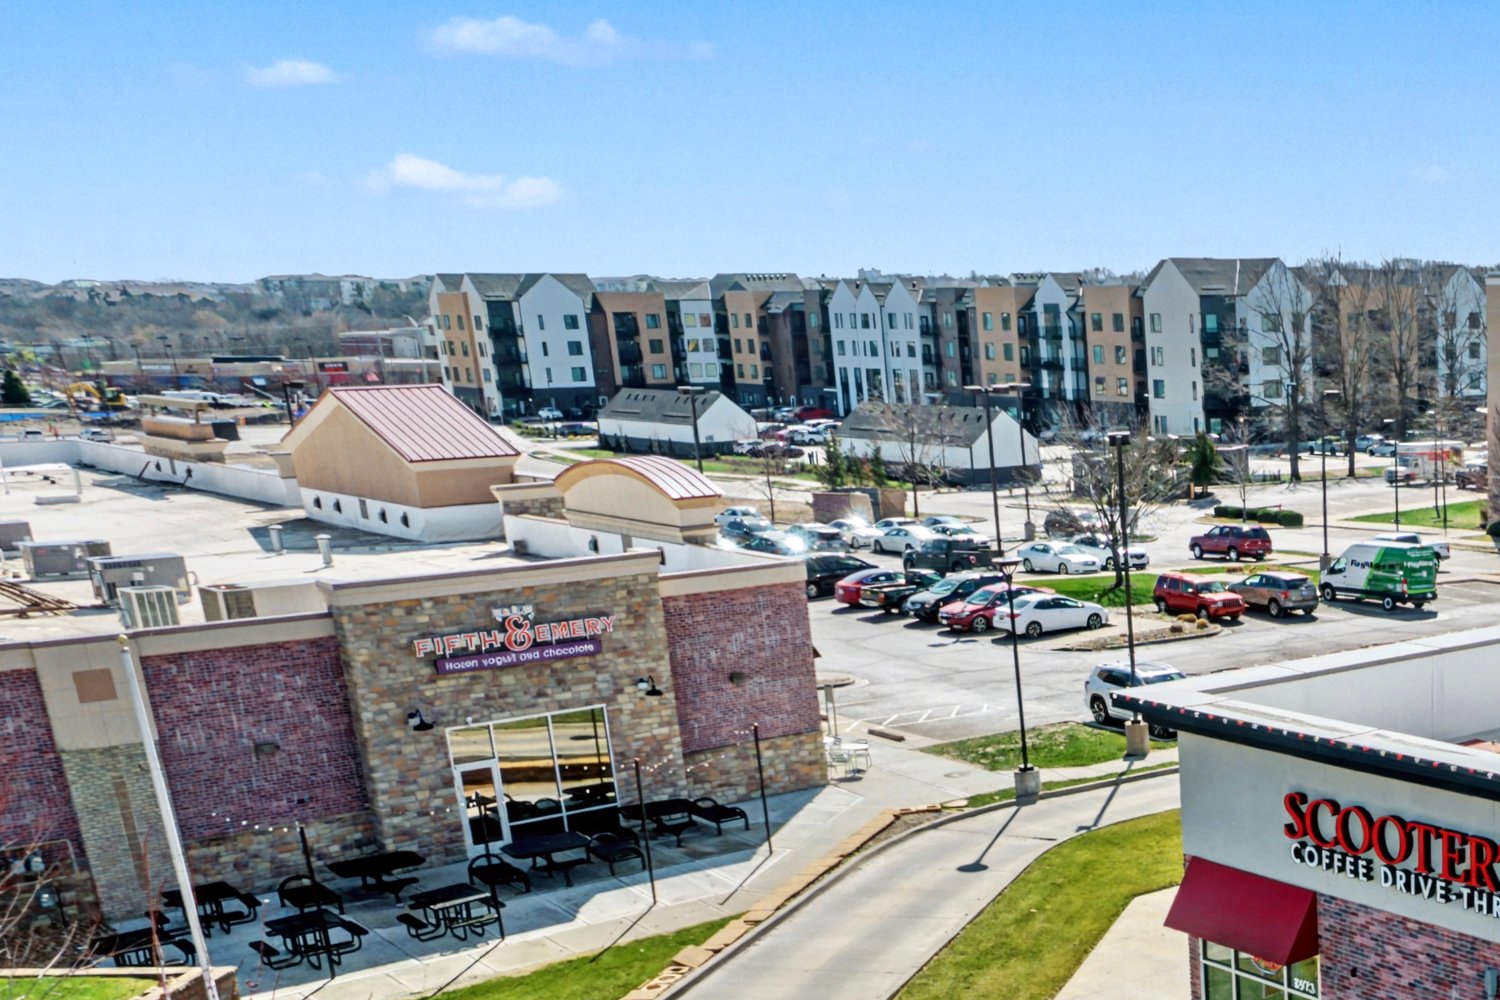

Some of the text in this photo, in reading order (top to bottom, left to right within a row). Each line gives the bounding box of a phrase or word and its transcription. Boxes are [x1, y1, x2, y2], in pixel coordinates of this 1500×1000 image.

[413, 615, 615, 658] FIFTH & EMERY
[1290, 841, 1373, 882] COFFEE
